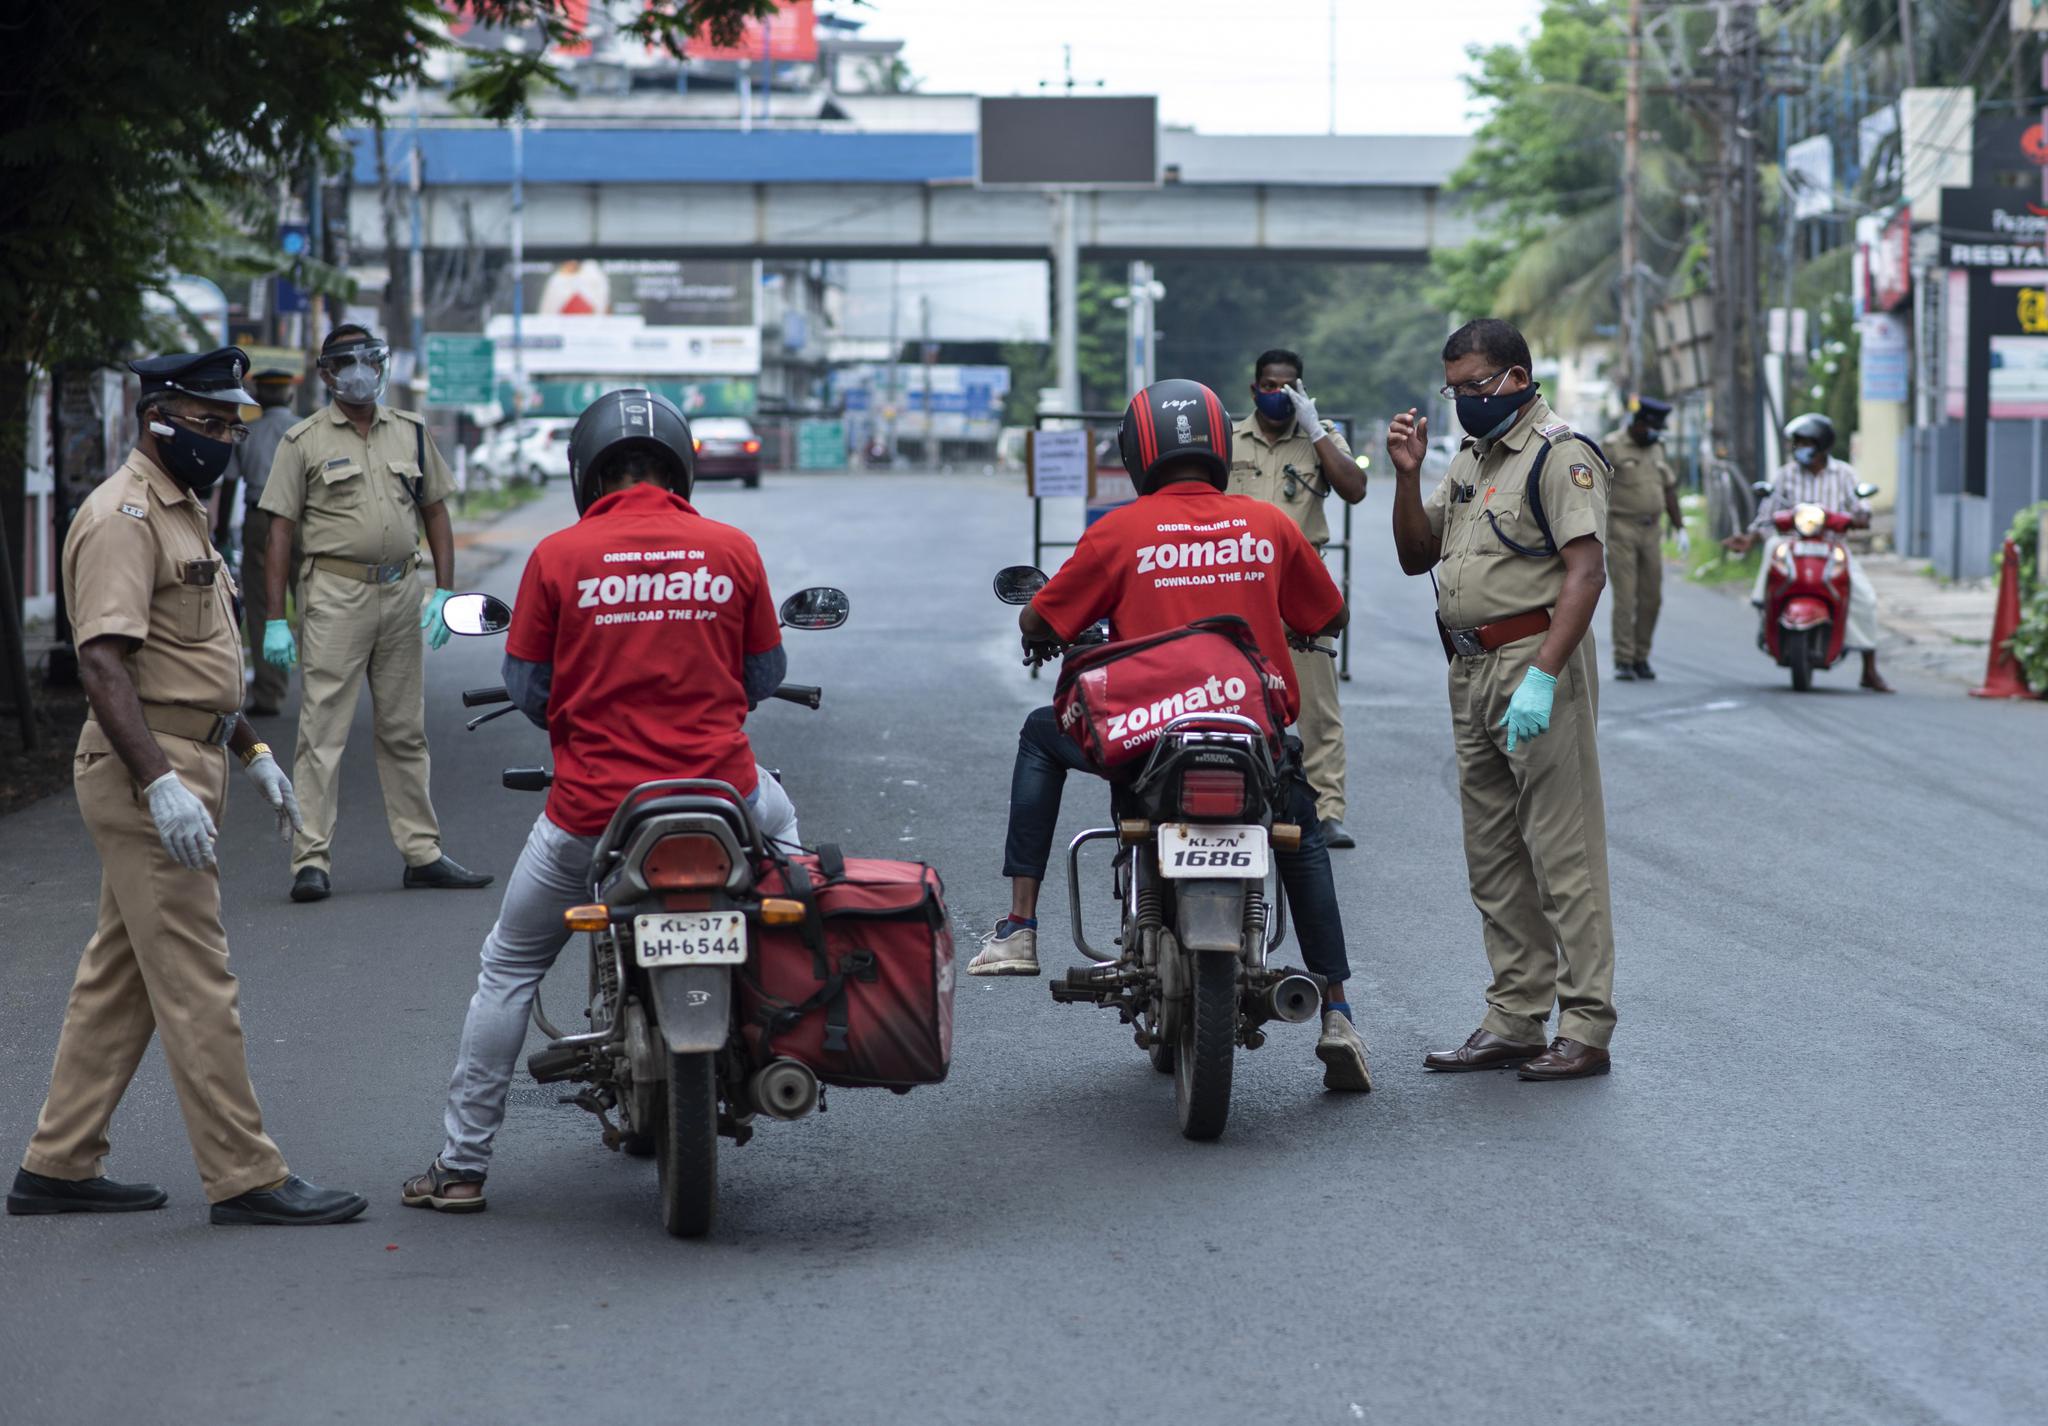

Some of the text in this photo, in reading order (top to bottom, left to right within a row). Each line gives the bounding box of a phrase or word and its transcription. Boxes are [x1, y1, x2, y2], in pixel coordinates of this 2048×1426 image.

[1951, 245, 2047, 266] RESTA
[1157, 518, 1247, 532] ORDER ONLINE ON
[603, 550, 705, 563] ORDER ONLINE ON
[1136, 531, 1275, 575] zomato
[577, 566, 734, 609] zomato
[1154, 572, 1265, 588] DOWNLOAD THE APP
[594, 609, 718, 626] DOWNLOAD THE APP
[1106, 674, 1247, 742] zomato
[1188, 838, 1240, 848] KL.7N
[1174, 851, 1252, 867] 1686
